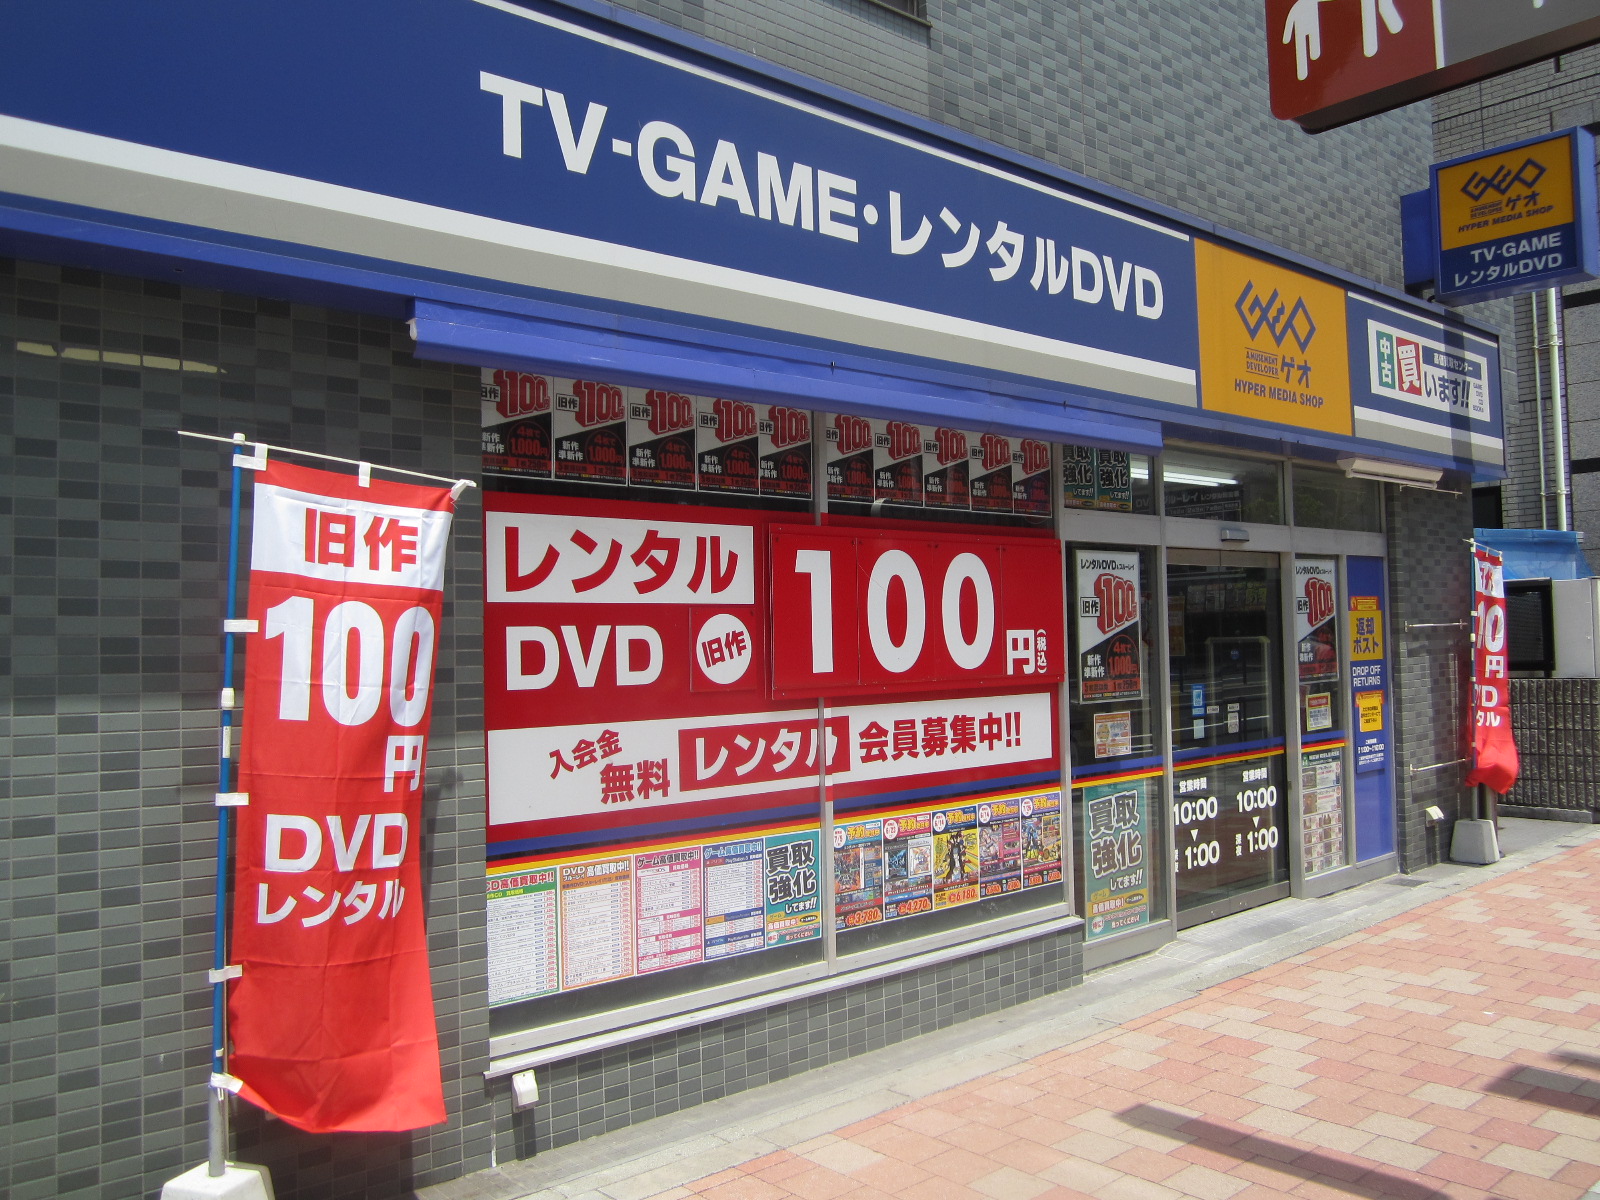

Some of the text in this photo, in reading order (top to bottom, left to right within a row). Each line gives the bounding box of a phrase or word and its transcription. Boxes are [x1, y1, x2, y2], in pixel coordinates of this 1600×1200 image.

[1505, 191, 1540, 211] ゲオ
[1459, 204, 1554, 232] HYPER MEDIA SHOP
[1470, 232, 1561, 264] TV-GAME
[1455, 253, 1562, 287] レンタルDVD
[1246, 351, 1278, 366] AMUSEMENT
[1246, 361, 1278, 376] DEVELOPER
[1281, 354, 1312, 388] ゲオ
[1380, 337, 1392, 384] 中古
[1235, 378, 1324, 408] HYPER MEDIA SHOP
[1098, 467, 1129, 489] 強化
[305, 508, 420, 572] 旧作
[505, 526, 739, 595] レンタル
[1082, 600, 1099, 614] 旧作
[1356, 617, 1374, 635] 返却
[506, 625, 664, 691] DVD
[701, 629, 748, 668] 旧作
[1353, 637, 1379, 654] ポスト
[265, 595, 436, 727] 100
[1087, 654, 1101, 667] 新作
[1352, 665, 1381, 676] DROP OFF
[1485, 655, 1503, 679] 円
[1354, 676, 1380, 687] RETURNS
[548, 729, 623, 780] 入会金
[696, 712, 1022, 778] レンタル 会員募集中!!
[383, 735, 424, 793] 円
[1243, 767, 1267, 782] 営業時間
[600, 757, 671, 804] 無料
[1179, 777, 1207, 793] 営業時間
[1174, 796, 1218, 825] 10:00
[1237, 786, 1277, 812] 10:00
[1089, 790, 1139, 838] 買取
[265, 812, 408, 874] DVD
[1247, 826, 1278, 852] 1:00
[638, 850, 700, 868] ゲーム高価買取中!!
[766, 840, 815, 876] 買取
[1091, 829, 1143, 879] 強化
[1185, 841, 1220, 869] 1:00
[563, 866, 585, 876] DVD
[767, 868, 817, 904] 強化
[258, 877, 405, 927] レンタル
[785, 897, 817, 913] してます!!
